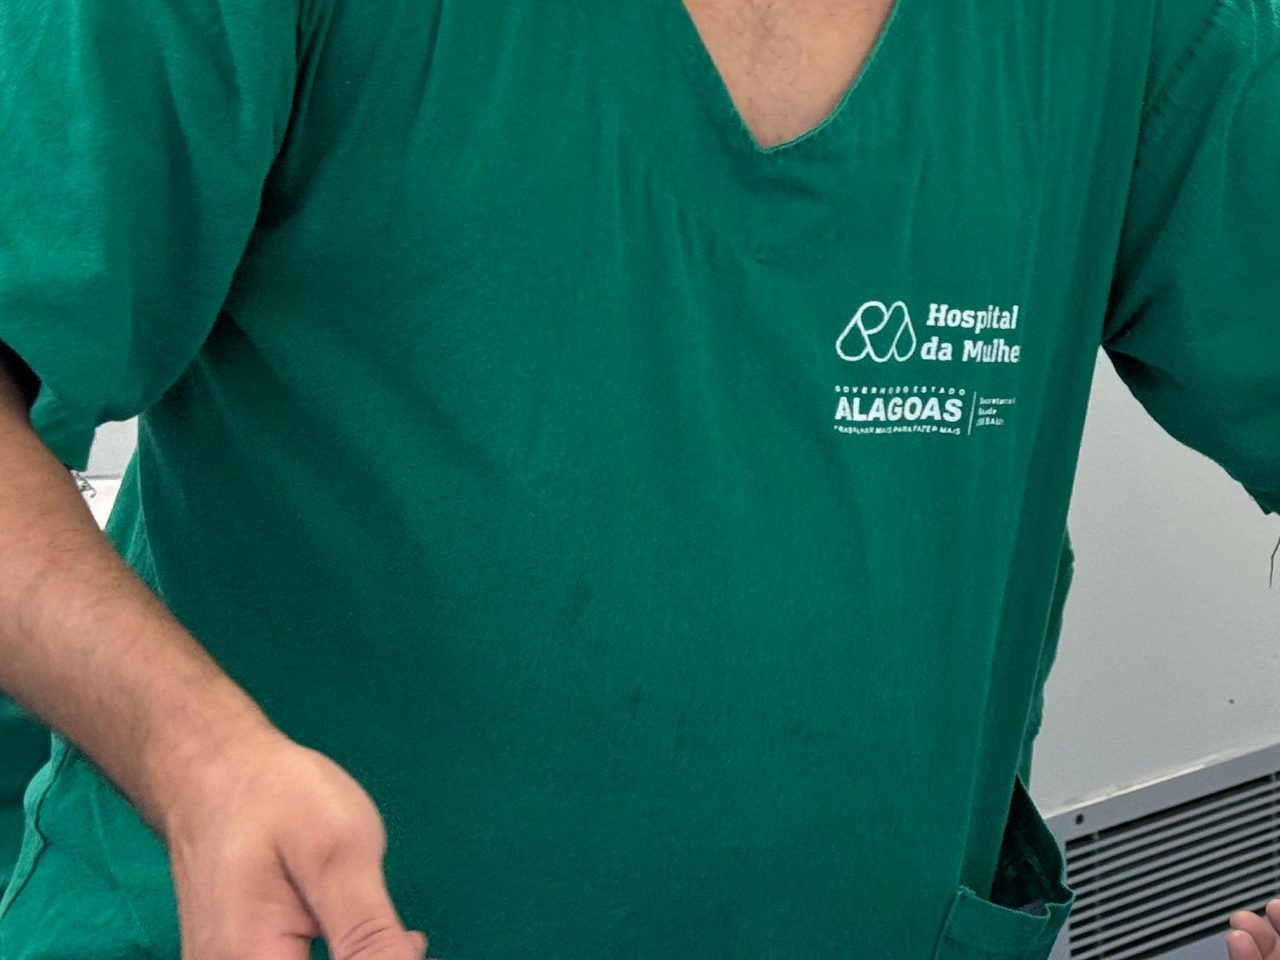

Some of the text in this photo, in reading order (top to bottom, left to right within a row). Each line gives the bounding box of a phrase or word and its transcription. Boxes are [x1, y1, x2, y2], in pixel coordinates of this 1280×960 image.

[926, 303, 1020, 334] Hospital
[920, 336, 1020, 362] da Mulhe
[834, 396, 963, 422] ALAGOAS
